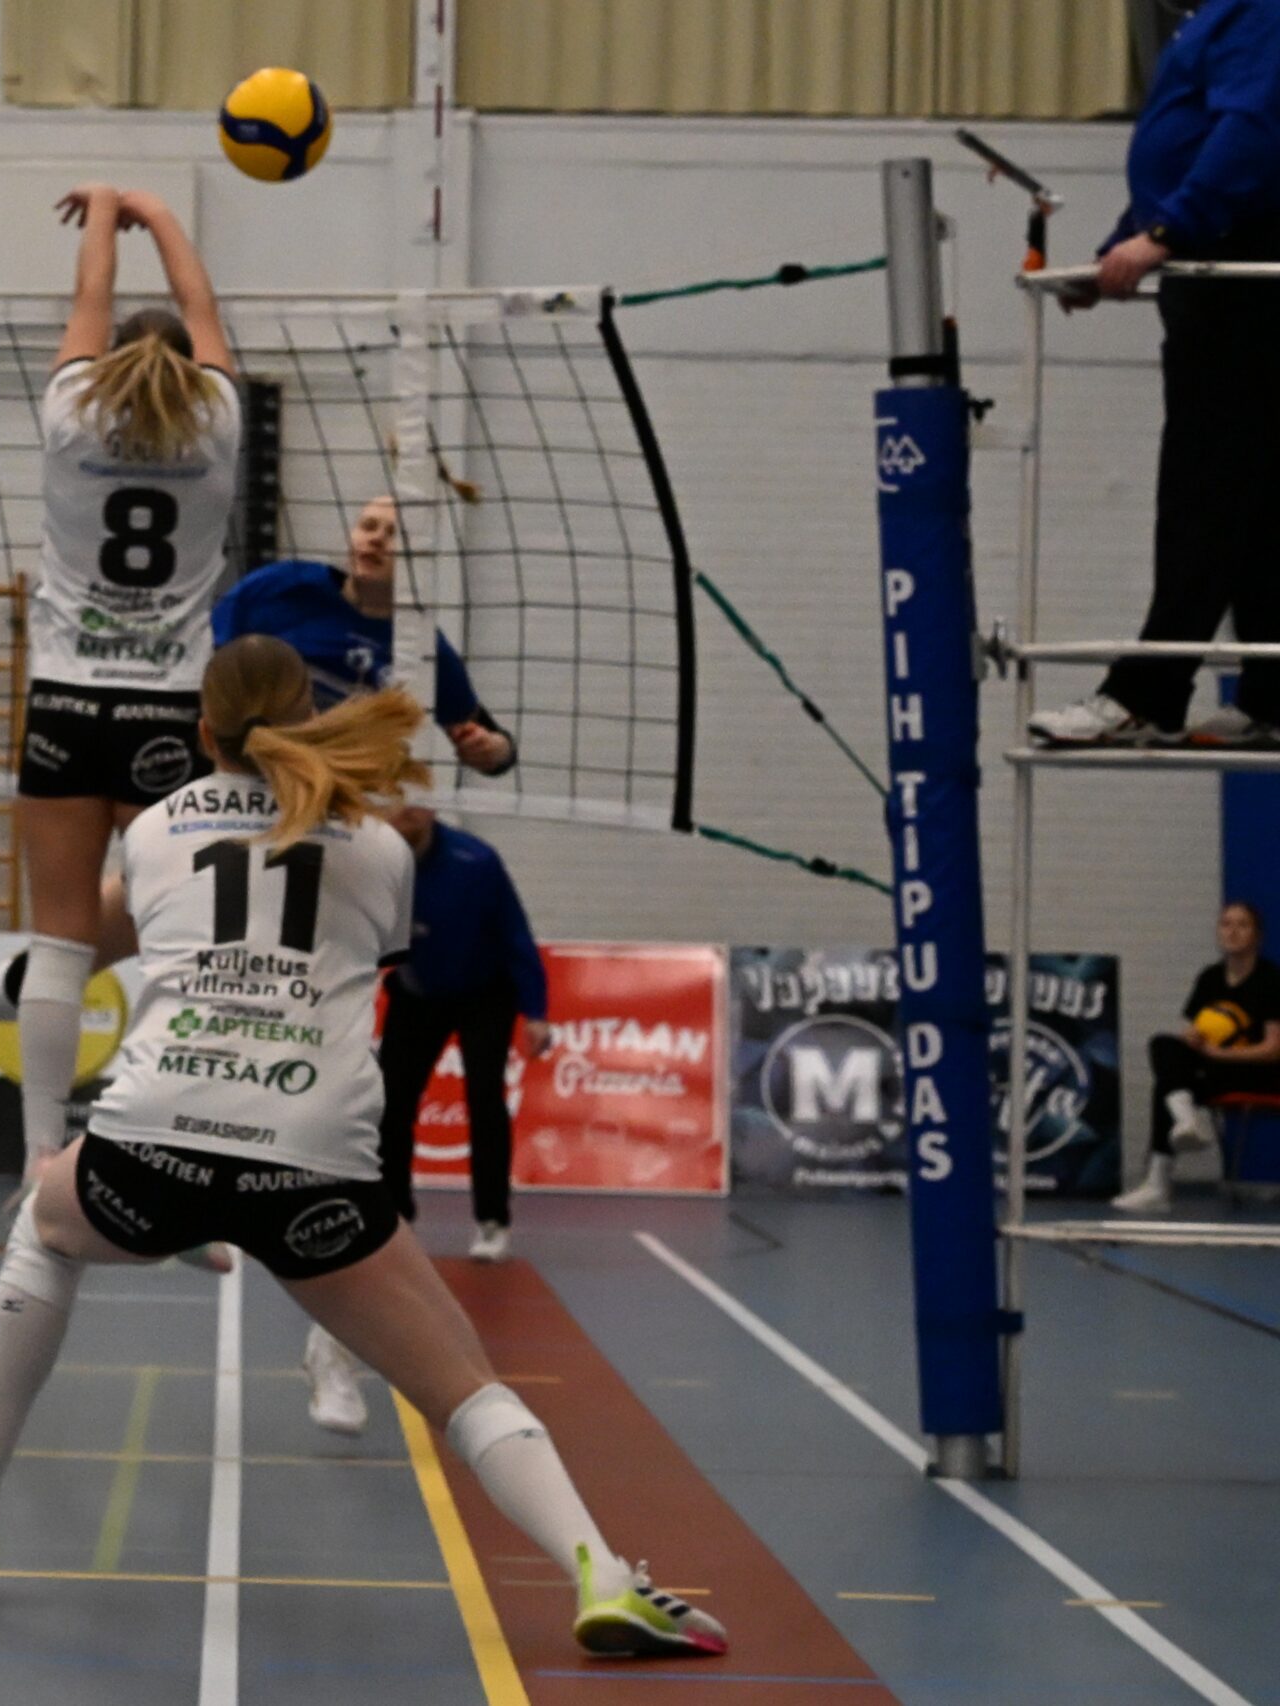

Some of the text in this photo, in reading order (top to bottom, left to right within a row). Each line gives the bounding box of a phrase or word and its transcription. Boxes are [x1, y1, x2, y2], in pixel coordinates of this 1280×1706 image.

[99, 487, 179, 588] 8
[193, 838, 326, 954] 11
[197, 950, 310, 977] Kuljetus
[289, 979, 324, 1008] Oy
[205, 1016, 325, 1046] APTEEKKI
